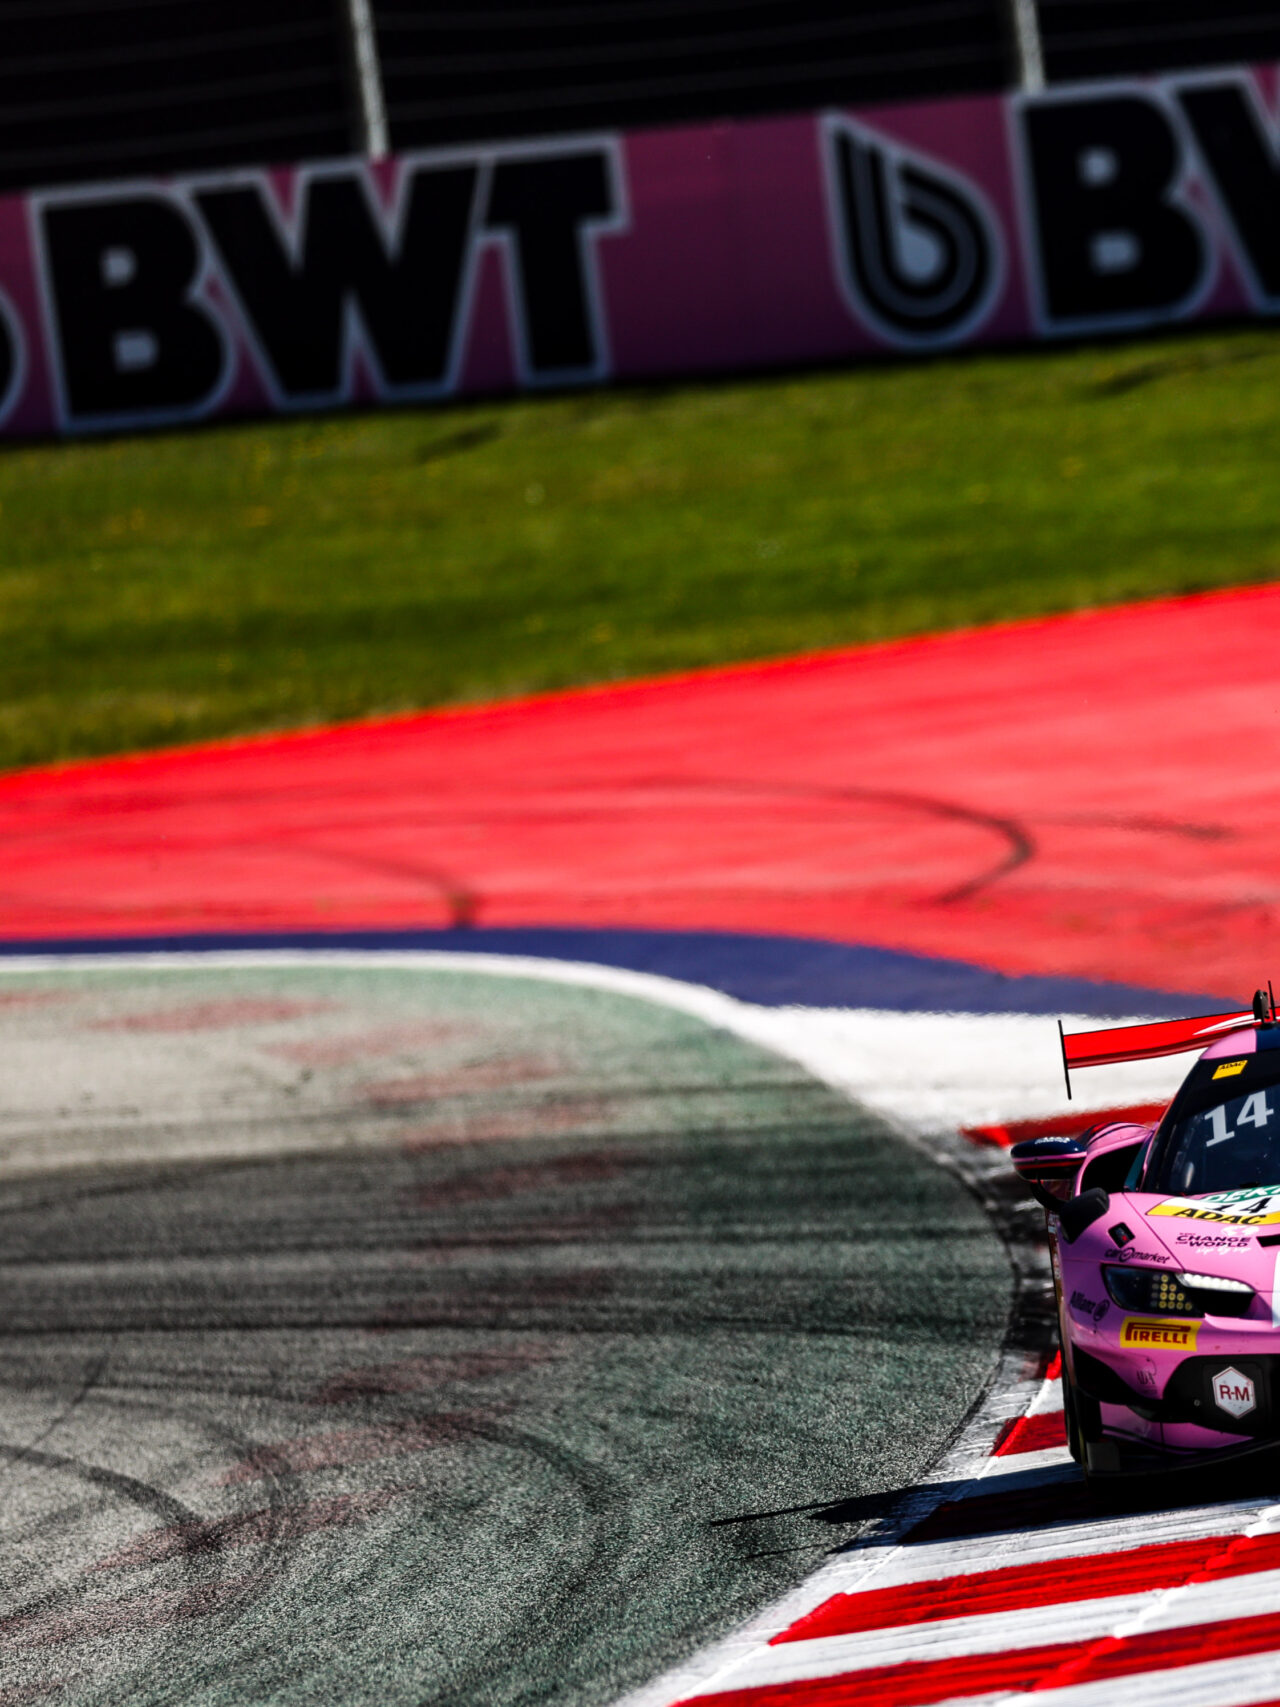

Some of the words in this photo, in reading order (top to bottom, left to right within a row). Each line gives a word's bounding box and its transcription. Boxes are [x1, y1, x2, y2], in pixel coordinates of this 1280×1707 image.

[30, 133, 630, 433] BWT
[1204, 1090, 1274, 1148] 14
[1204, 1196, 1273, 1214] 14
[1174, 1207, 1267, 1225] ADAC
[1176, 1235, 1252, 1243] CHANGE
[1125, 1322, 1192, 1344] PIRELLI
[1219, 1384, 1251, 1402] R-M
